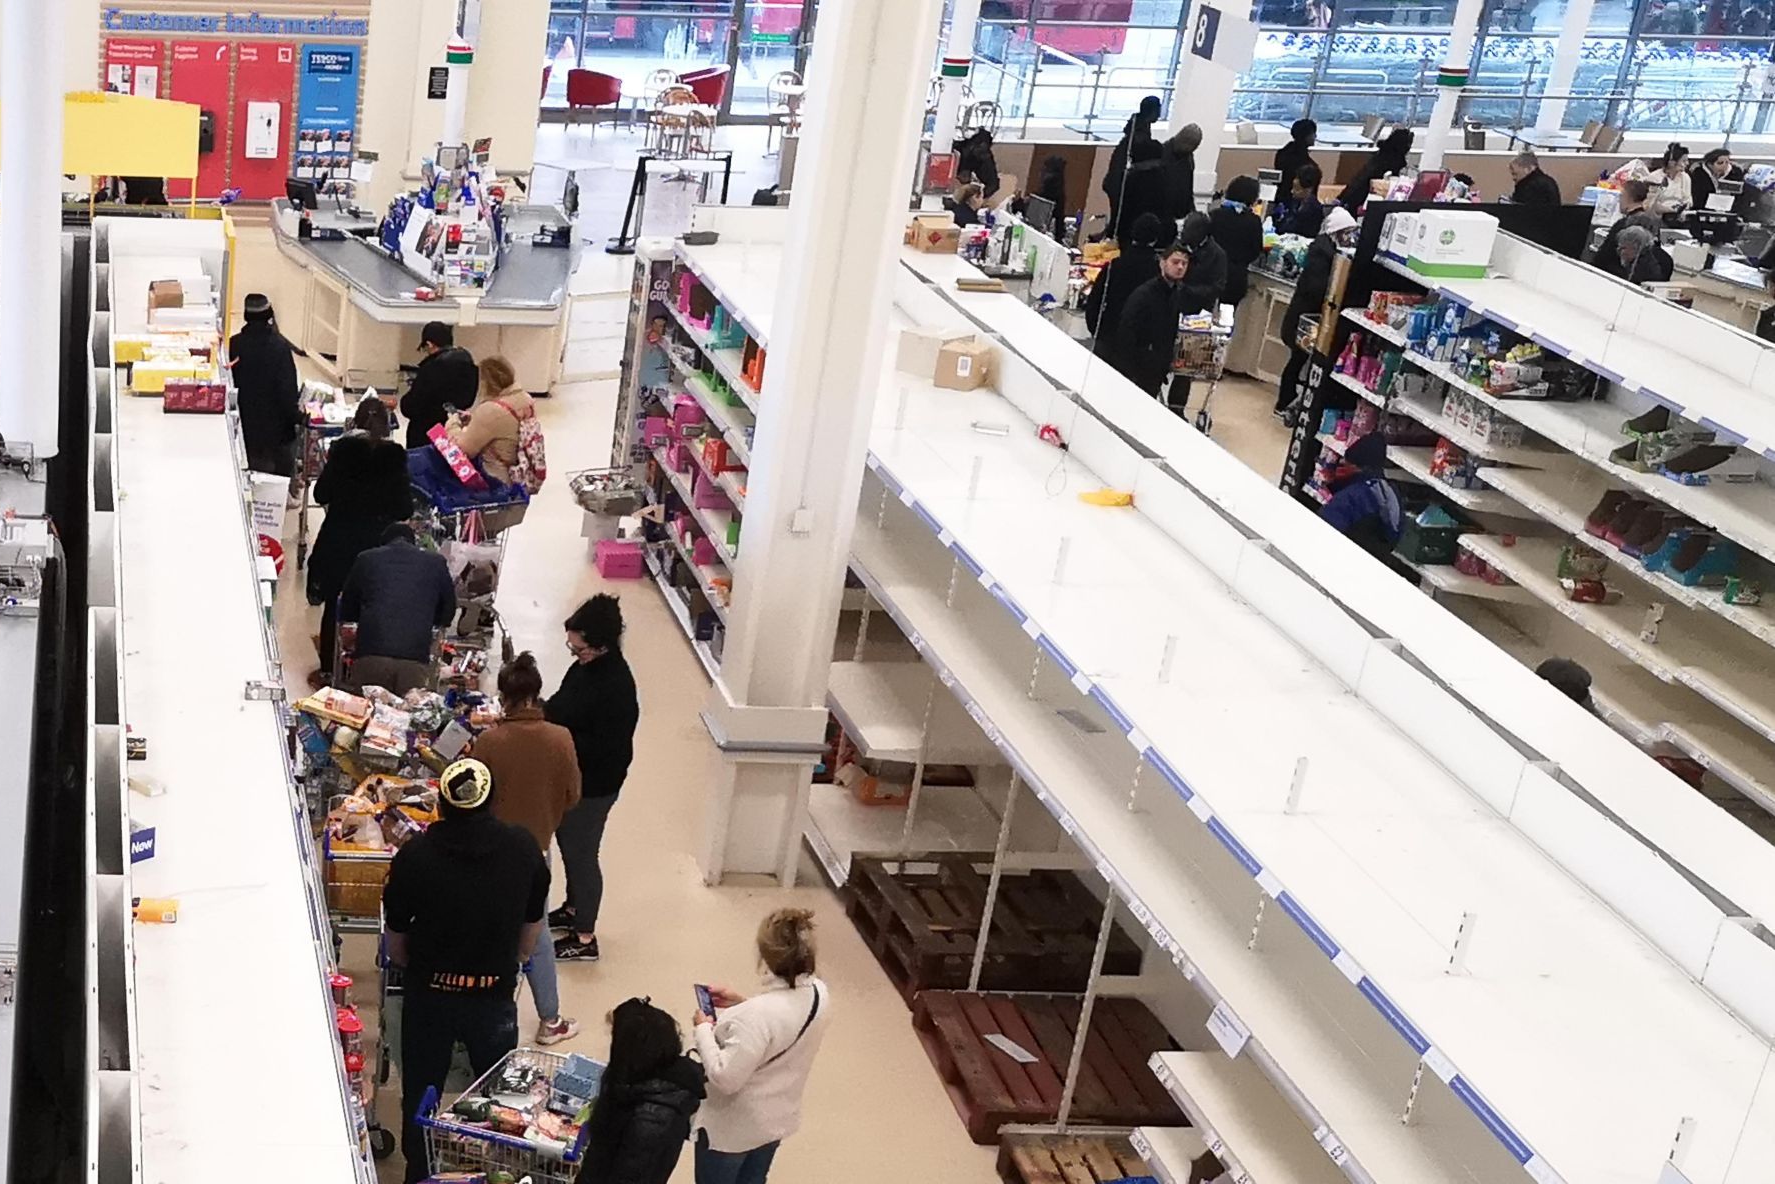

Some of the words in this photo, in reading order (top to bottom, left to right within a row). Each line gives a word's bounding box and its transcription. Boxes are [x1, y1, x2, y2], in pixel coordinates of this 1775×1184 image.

[105, 8, 218, 32] Customer
[226, 11, 368, 36] Information
[1195, 13, 1208, 48] 8
[131, 839, 154, 854] Now
